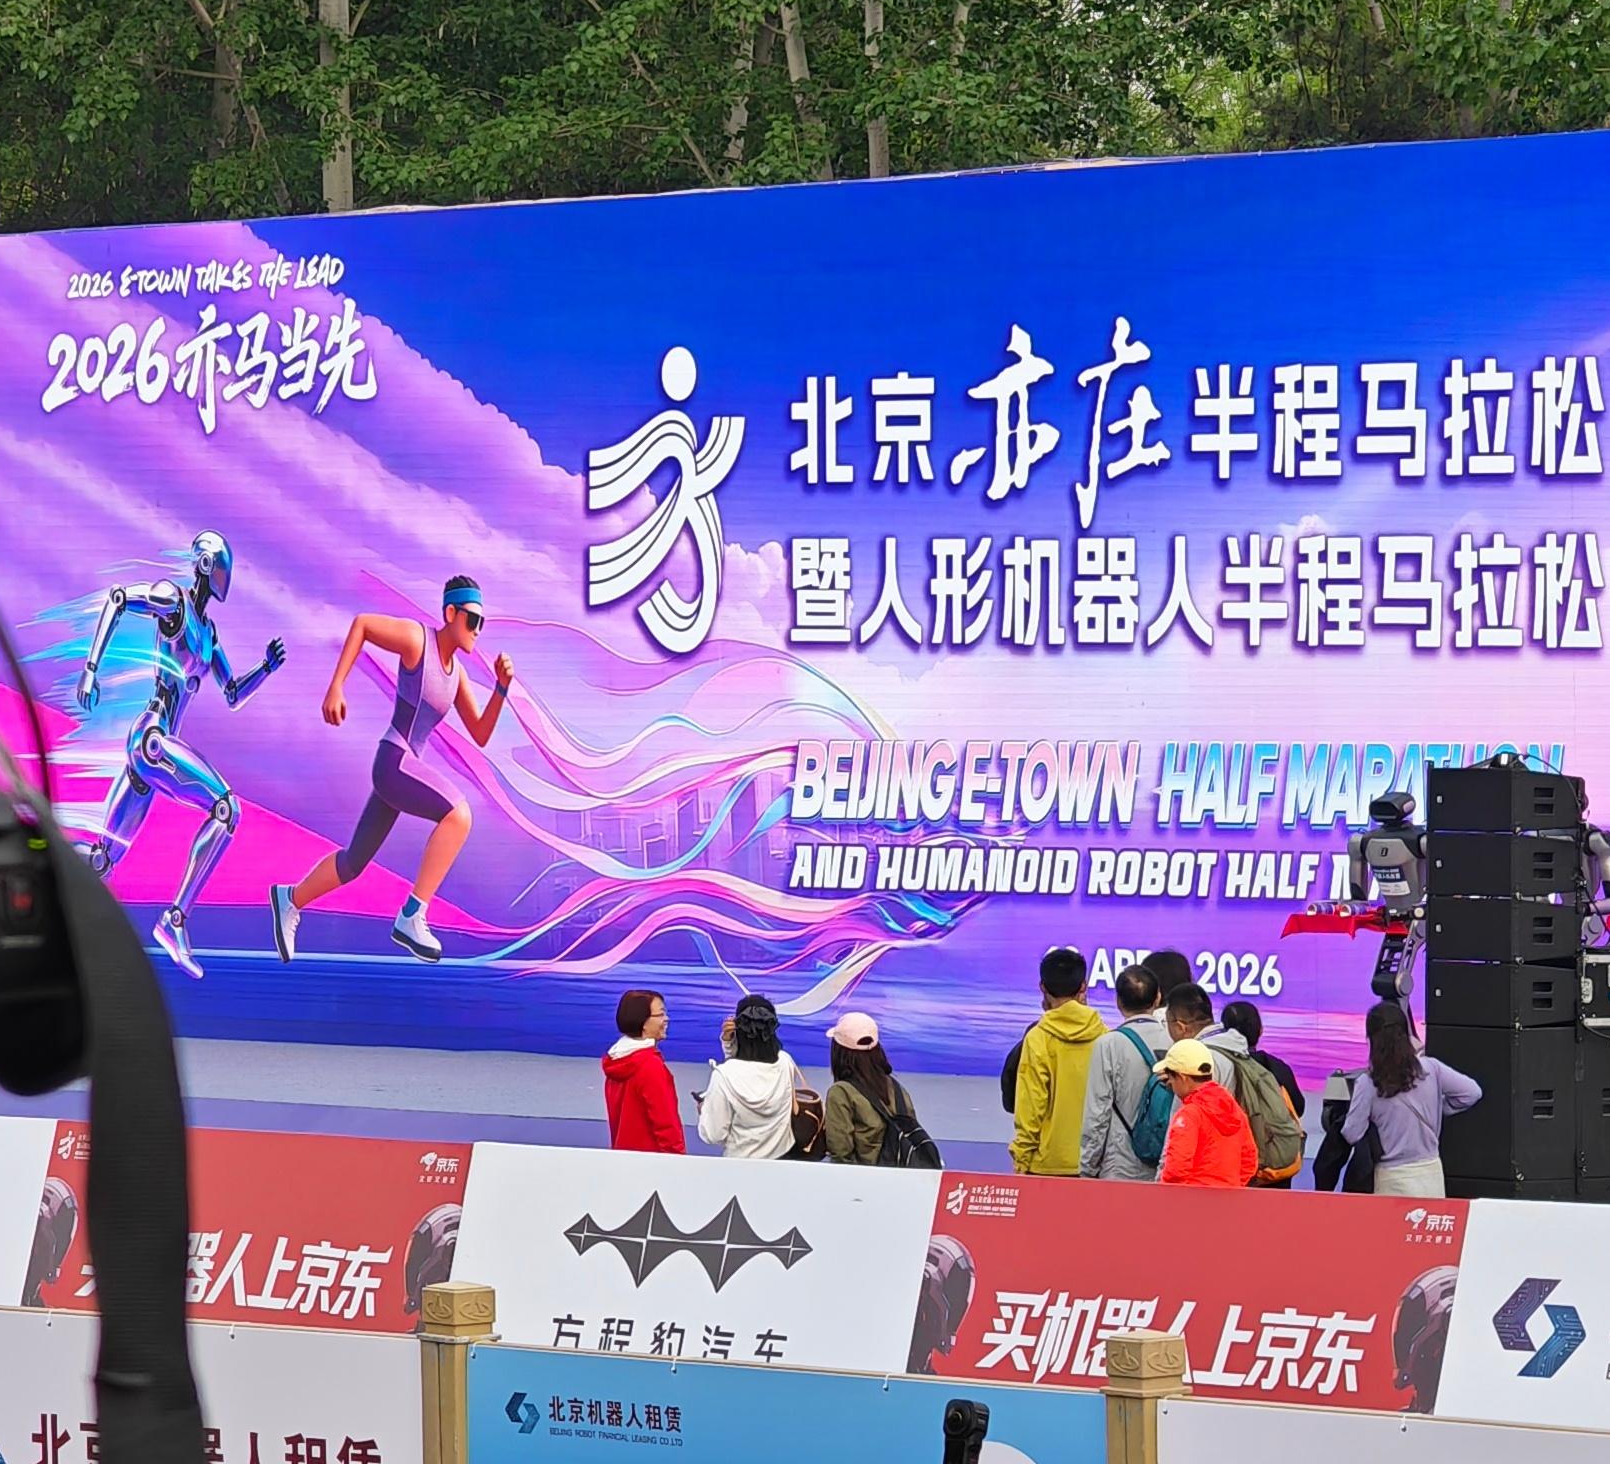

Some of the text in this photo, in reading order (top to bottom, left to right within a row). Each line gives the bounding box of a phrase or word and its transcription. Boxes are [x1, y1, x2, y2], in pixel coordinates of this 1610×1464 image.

[67, 271, 114, 299] 2026
[196, 258, 252, 296] TAKES
[258, 253, 292, 300] THE
[293, 253, 344, 289] LEAD
[790, 534, 1605, 648] 暨人形机器人半程马拉松
[793, 740, 956, 824] BEIJING
[968, 740, 1139, 826] E-TOWN
[1156, 741, 1280, 829] HALF
[791, 844, 867, 890] AND
[876, 846, 1077, 894] HUMANOID
[1088, 849, 1217, 897] ROBOT
[1225, 852, 1322, 900] HALF
[1195, 951, 1283, 996] 2026
[434, 1157, 460, 1173] 京东
[1425, 1214, 1456, 1232] 京东
[74, 1229, 394, 1320] 器人上京东
[549, 1395, 683, 1433] 北京机器人租赁
